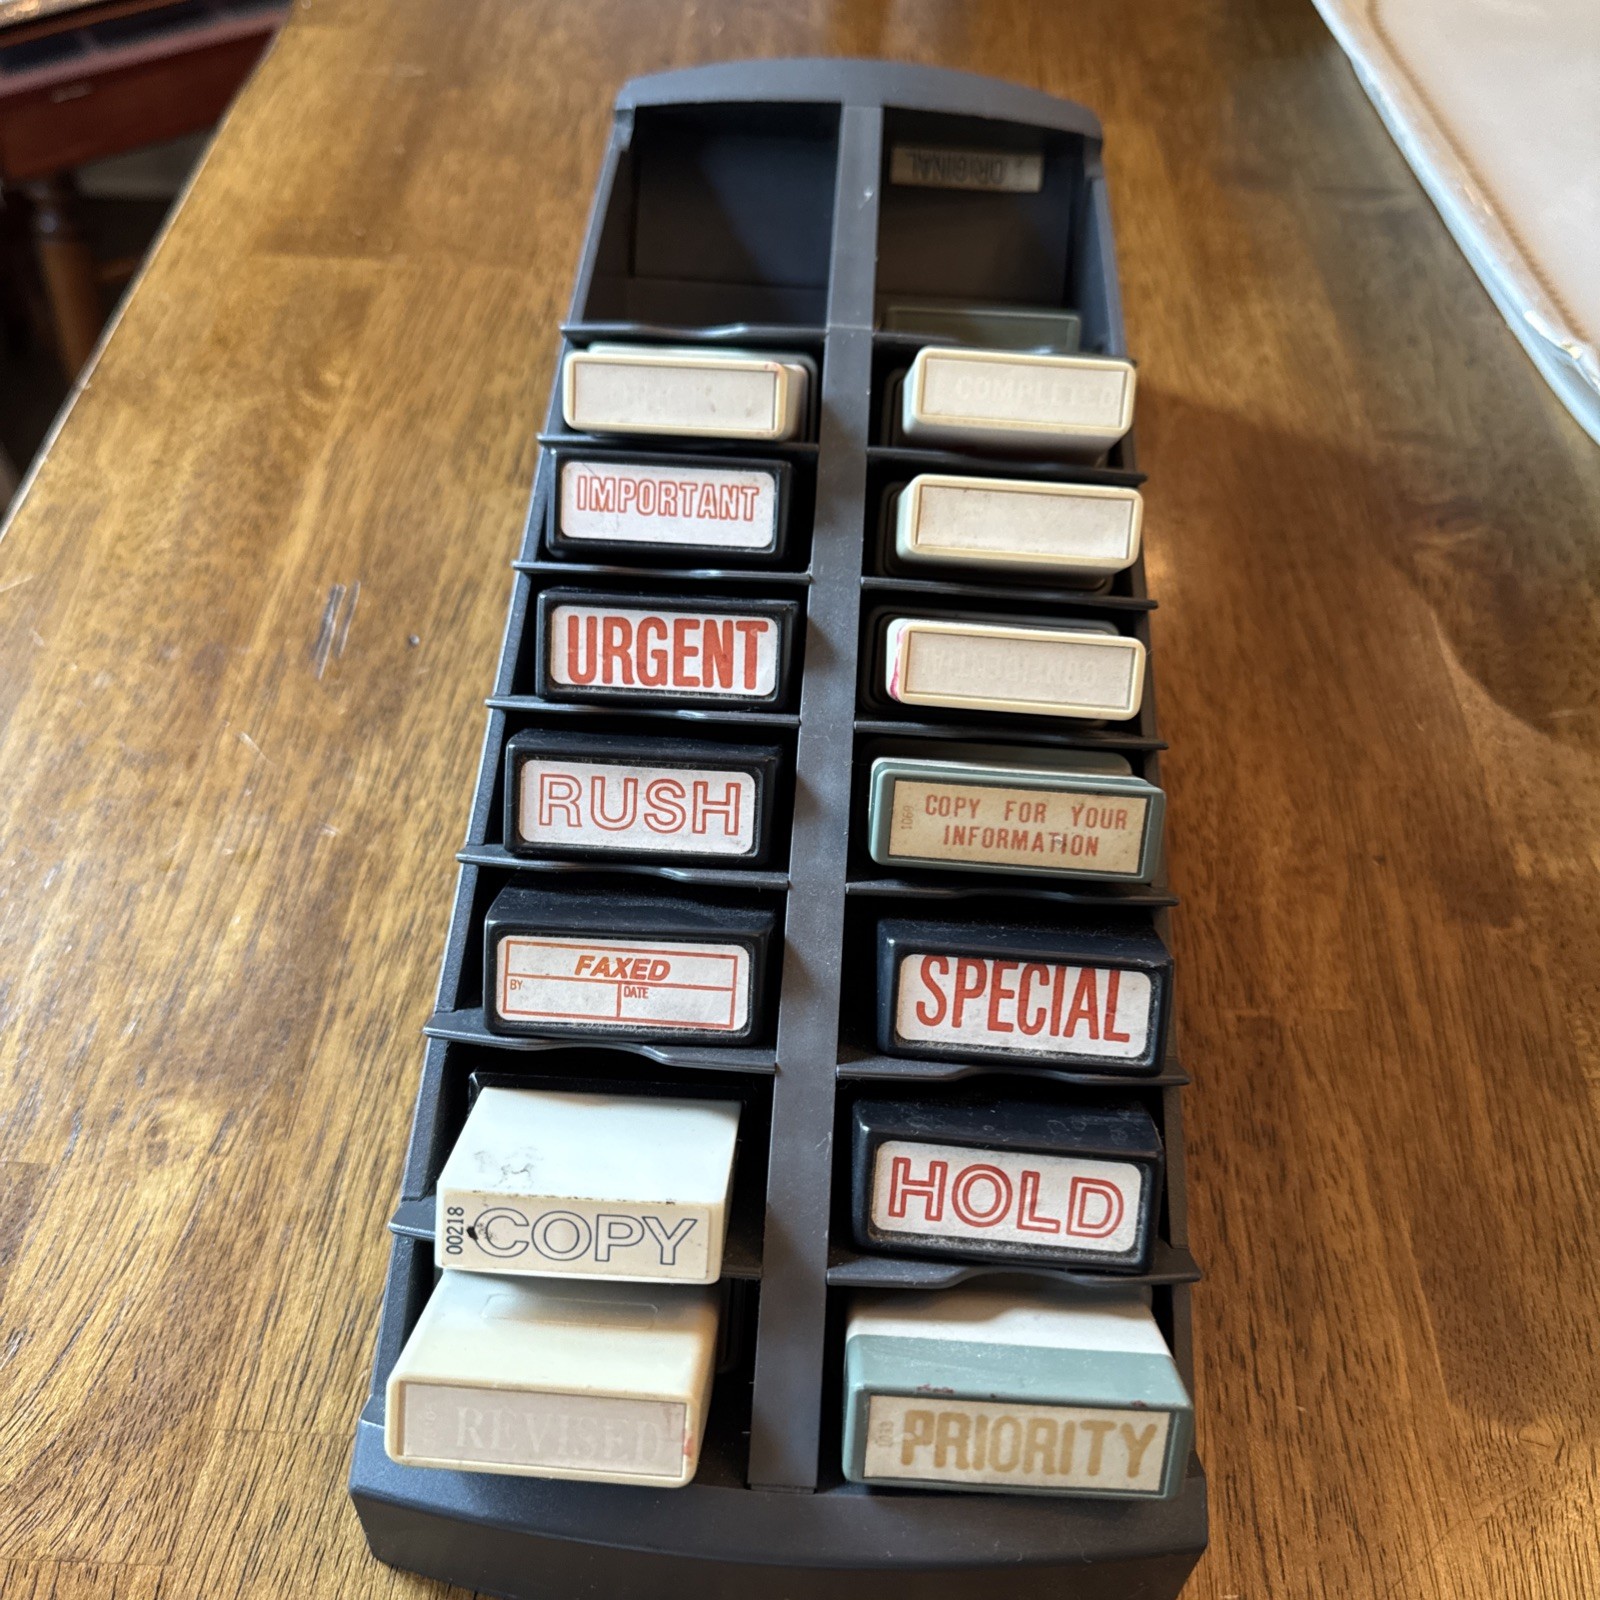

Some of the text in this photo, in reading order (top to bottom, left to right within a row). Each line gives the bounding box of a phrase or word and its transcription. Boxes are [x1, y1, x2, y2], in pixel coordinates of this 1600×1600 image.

[577, 476, 759, 522] IMPORTANT
[567, 614, 769, 690] URGENT
[539, 773, 741, 836] RUSH
[900, 805, 914, 830] 1069
[925, 793, 1129, 831] COPY FOR YOUR
[942, 825, 1100, 857] INFORMATION
[509, 978, 523, 991] BY
[574, 955, 671, 981] FAXED
[623, 986, 649, 999] DATE
[915, 954, 1130, 1044] SPECIAL
[888, 1156, 1124, 1239] HOLD
[446, 1206, 464, 1255] 00218
[472, 1207, 697, 1265] COPY
[455, 1406, 662, 1463] REVISED
[900, 1409, 1158, 1478] PRIORITY
